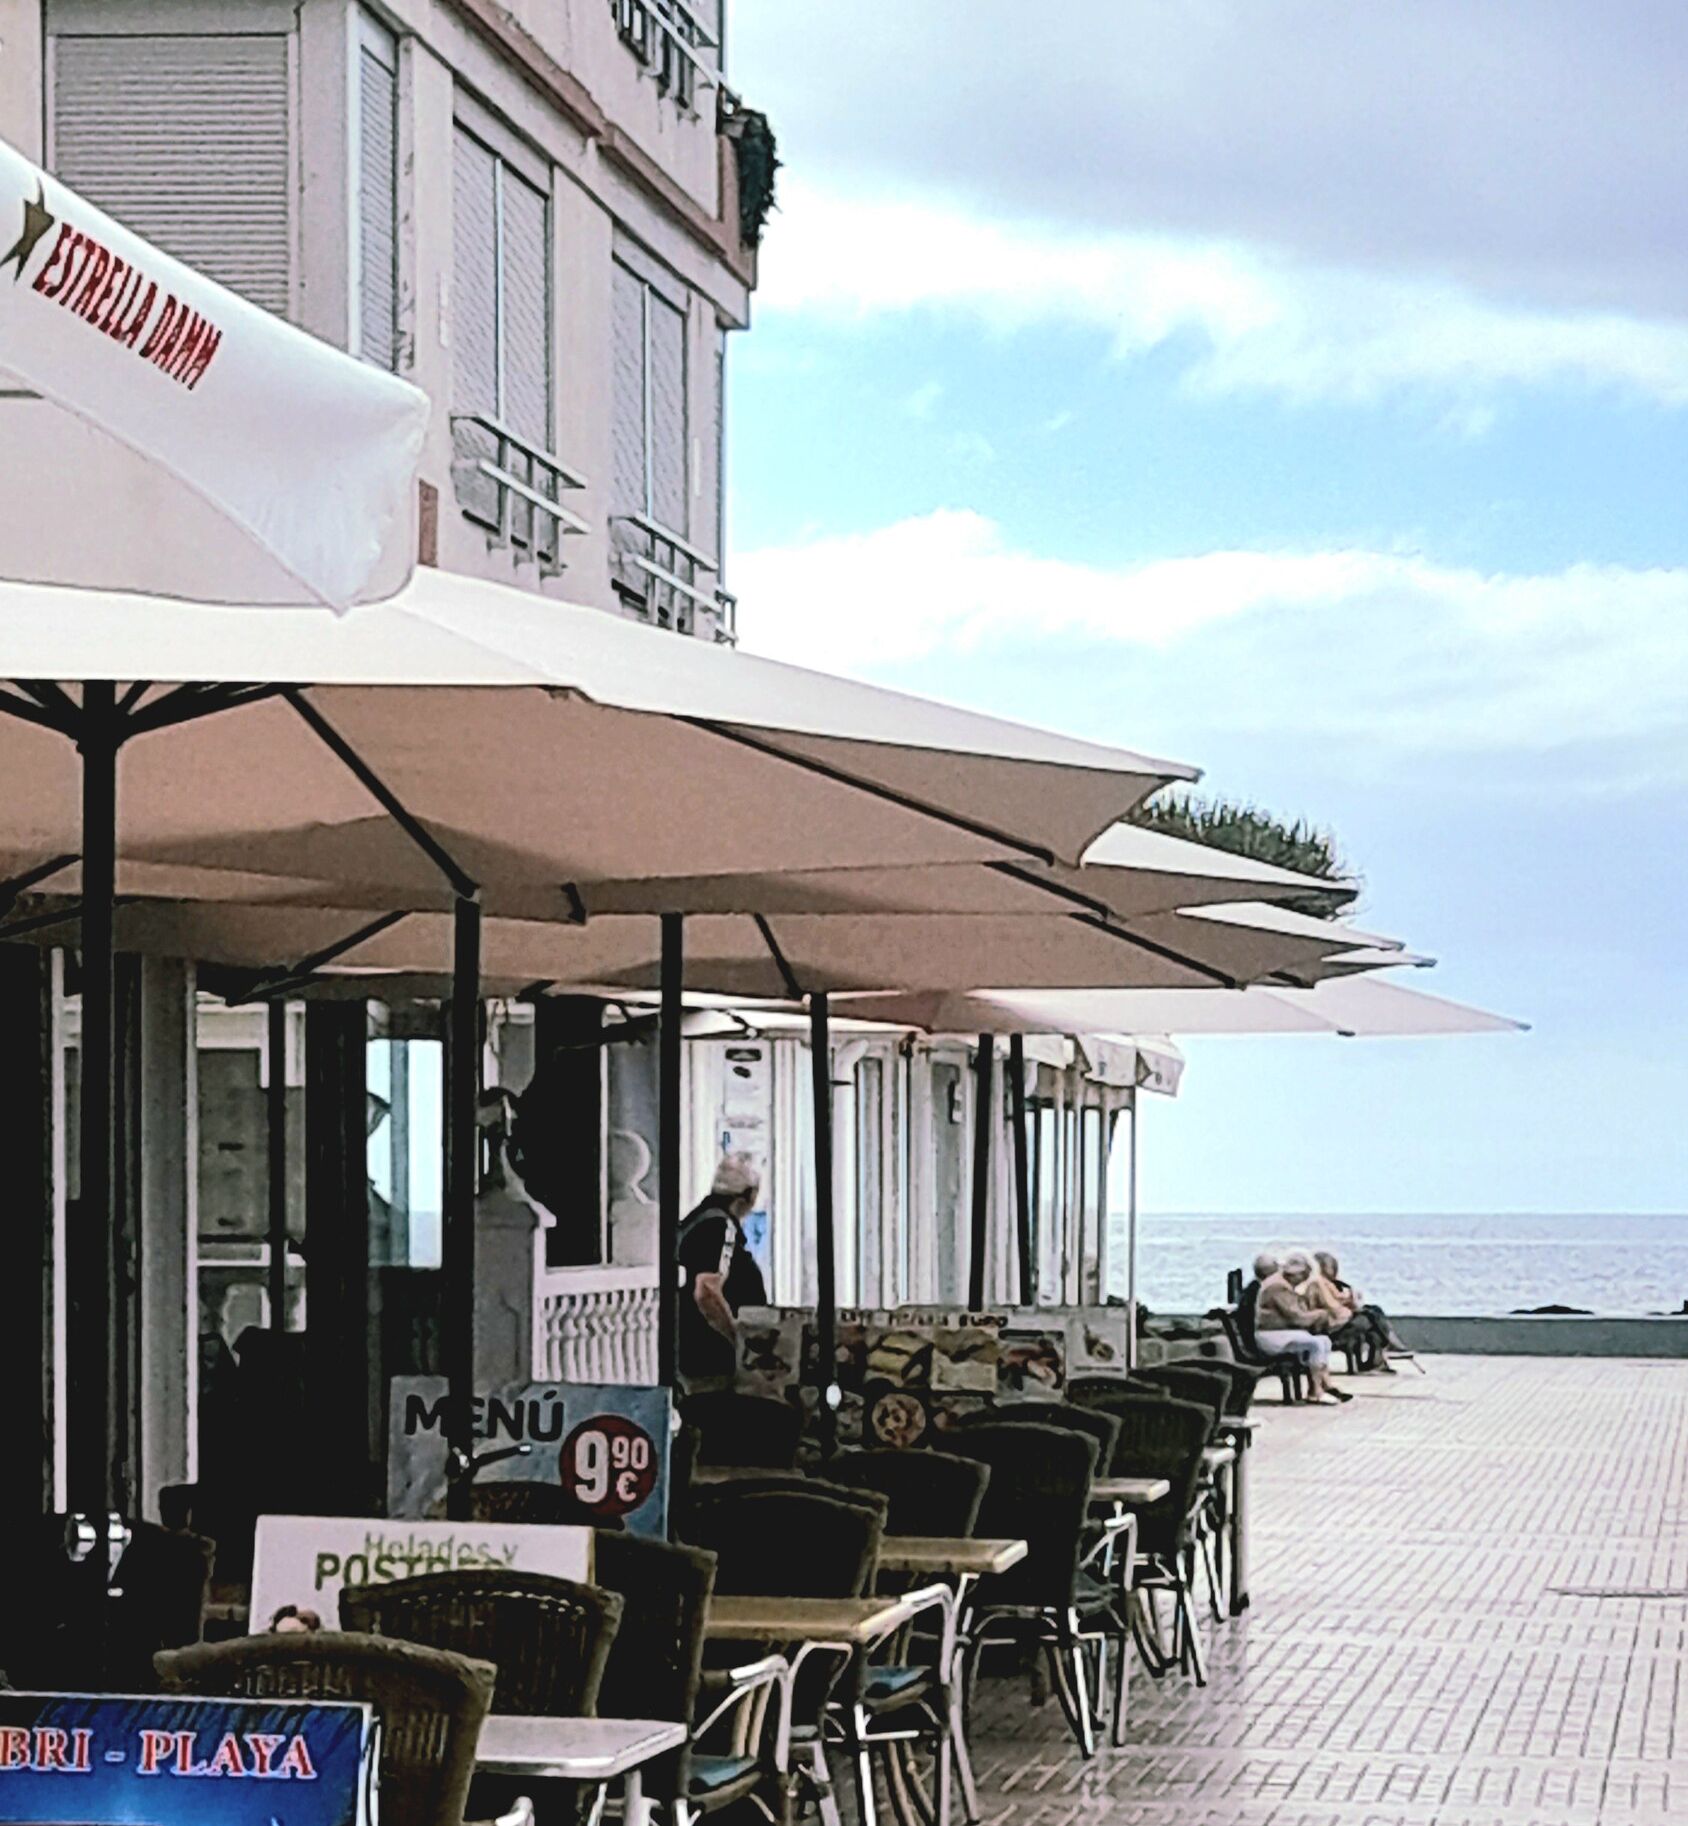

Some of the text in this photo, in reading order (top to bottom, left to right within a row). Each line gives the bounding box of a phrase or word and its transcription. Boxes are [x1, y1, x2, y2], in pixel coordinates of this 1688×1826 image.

[32, 222, 222, 390] ESTRELLA DAMM
[0, 1726, 94, 1772] BRI
[137, 1730, 317, 1779] PLAYA
